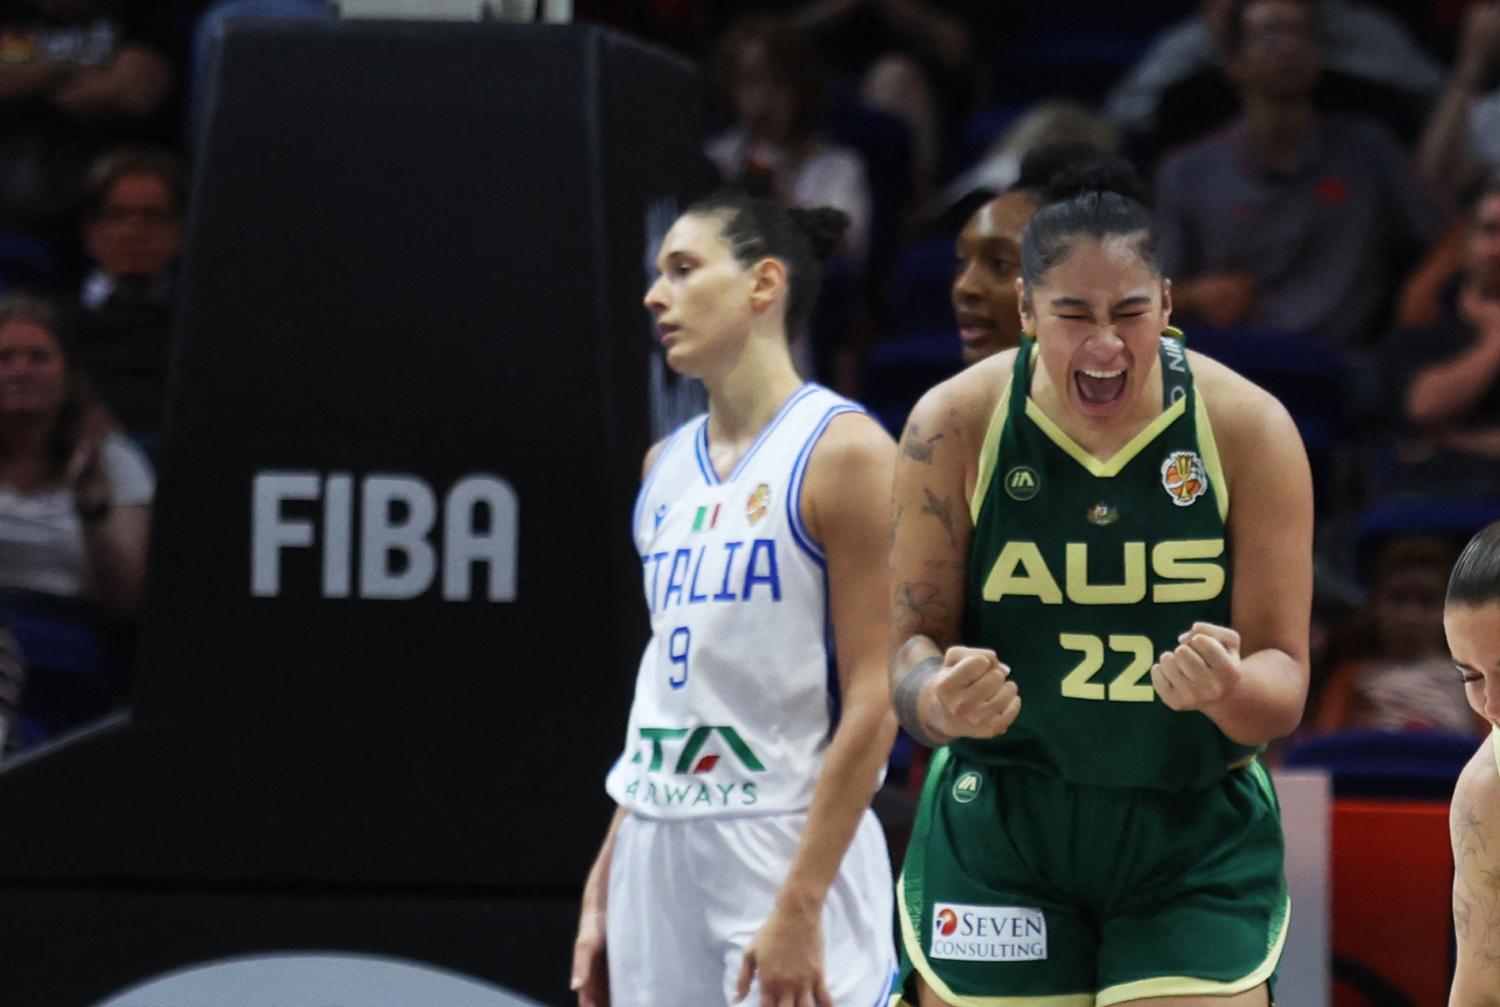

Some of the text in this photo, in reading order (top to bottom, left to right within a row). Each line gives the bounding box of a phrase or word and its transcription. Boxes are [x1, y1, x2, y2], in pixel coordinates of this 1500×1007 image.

[252, 472, 519, 602] FIBA
[641, 539, 782, 615] TALIA
[982, 538, 1226, 605] AUS
[668, 625, 691, 690] 9
[1058, 632, 1155, 702] 22
[934, 941, 1043, 958] CONSULTING
[960, 912, 1042, 938] SEVEN
